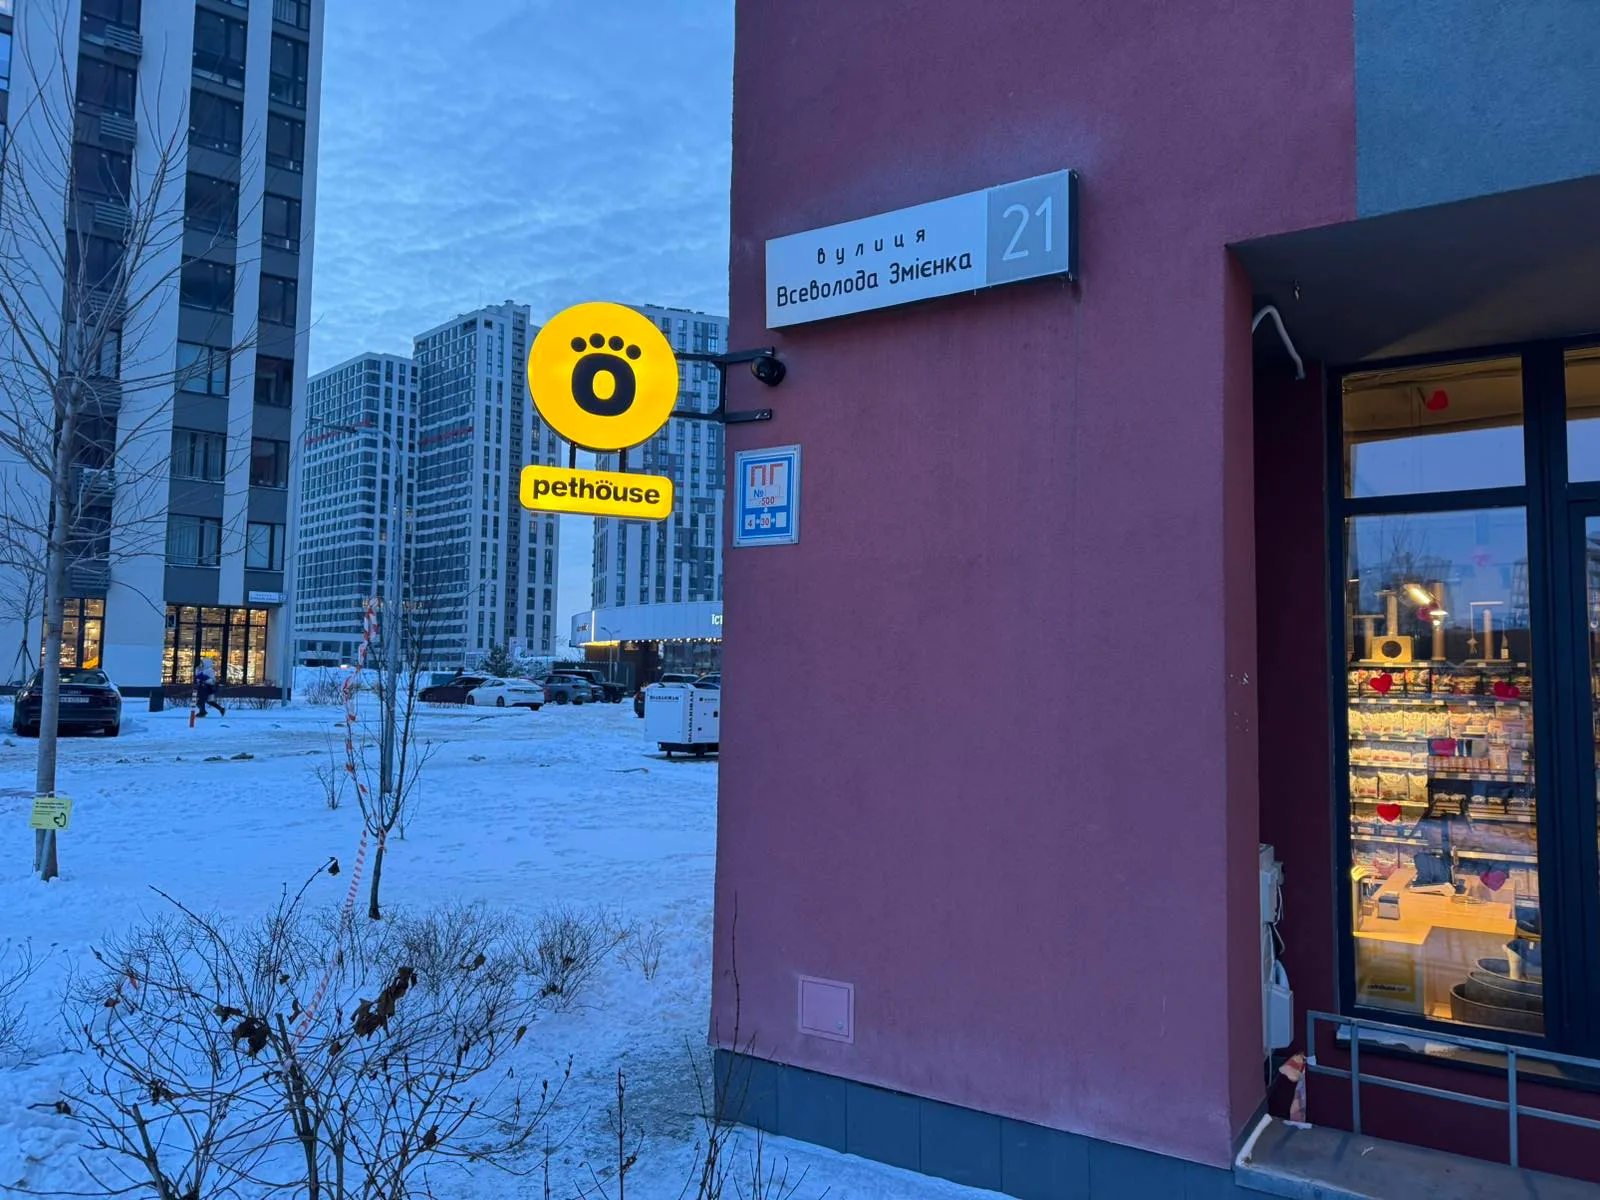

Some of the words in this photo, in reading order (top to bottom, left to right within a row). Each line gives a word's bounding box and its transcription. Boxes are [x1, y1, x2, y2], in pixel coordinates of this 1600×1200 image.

[817, 228, 926, 265] вулиця
[1003, 196, 1052, 261] 21
[777, 269, 879, 307] Всеволода
[889, 252, 972, 284] Змієнка
[750, 463, 784, 487] ПГ
